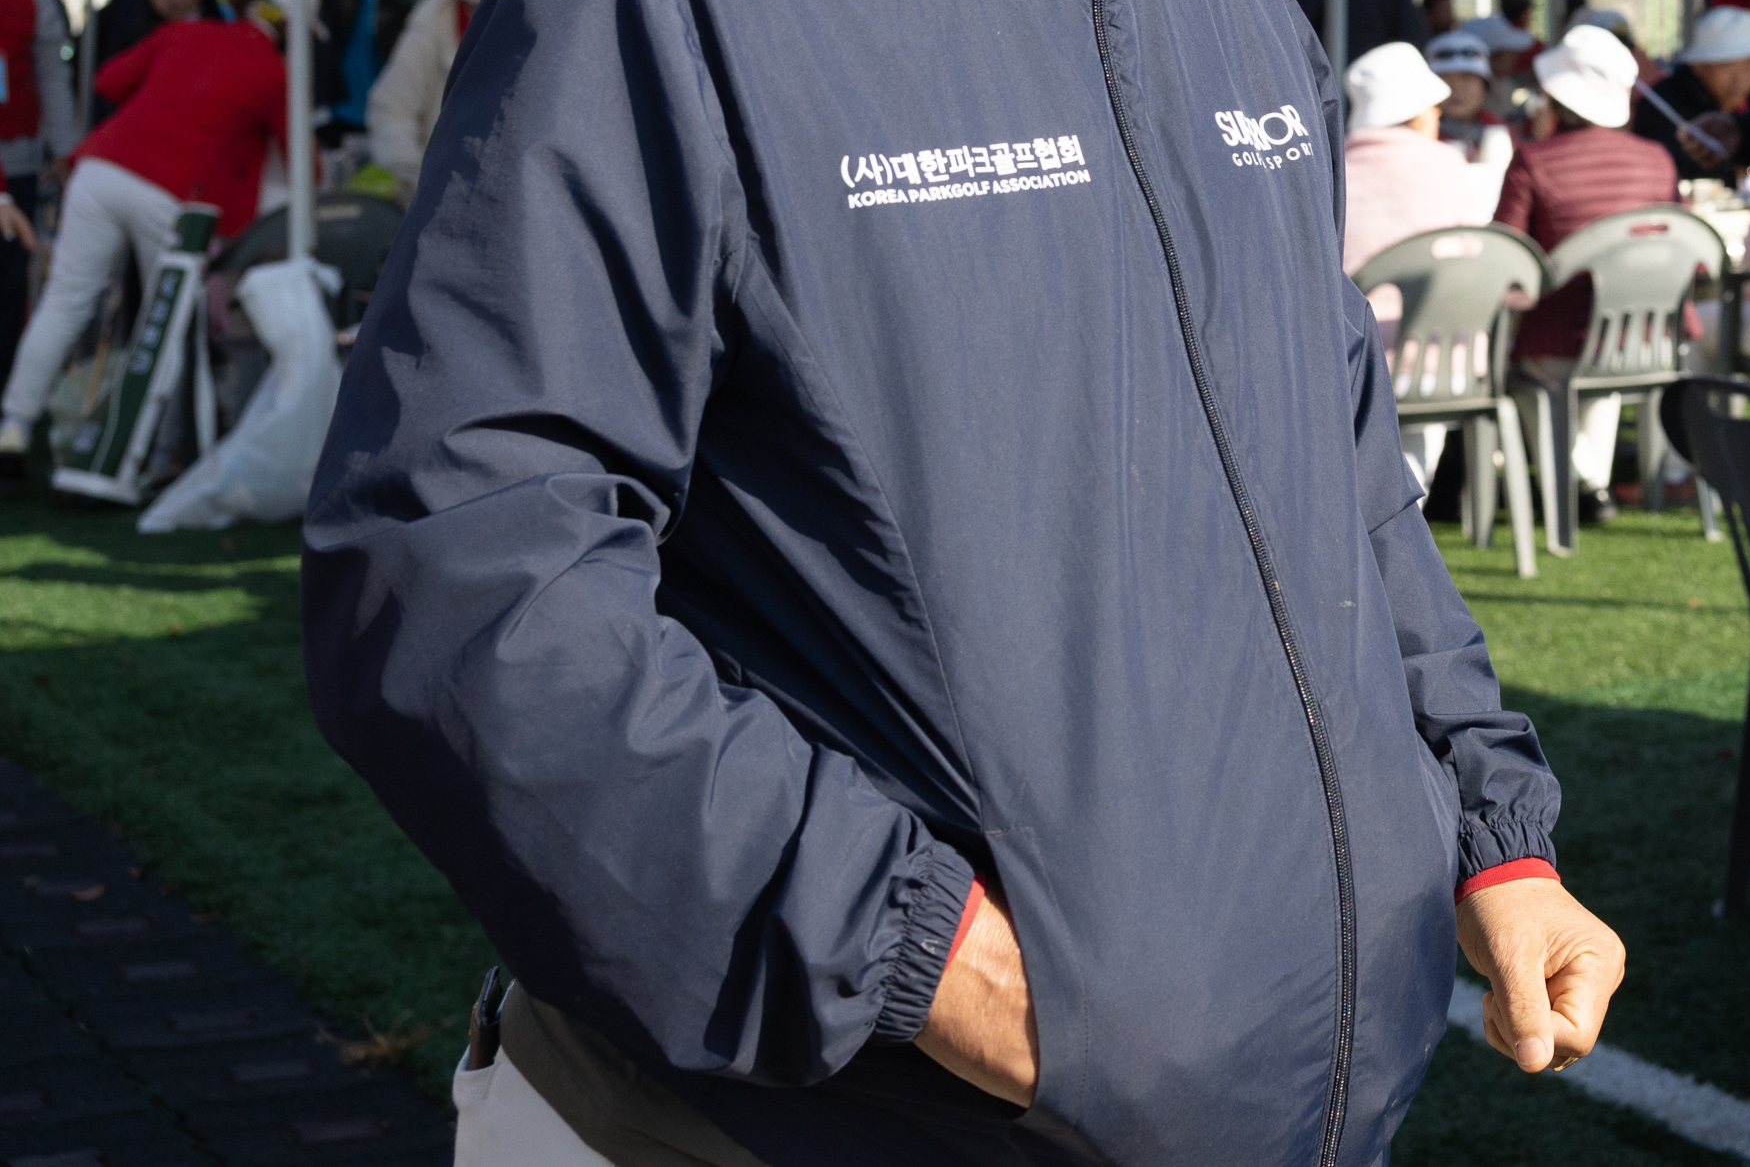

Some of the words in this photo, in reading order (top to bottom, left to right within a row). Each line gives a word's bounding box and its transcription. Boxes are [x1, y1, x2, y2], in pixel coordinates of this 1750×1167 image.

[841, 135, 1085, 188] (사)대한파크골프협회
[848, 188, 909, 209] KOREA
[908, 180, 991, 203] PARKGOLF
[992, 169, 1092, 194] ASSOCIATION
